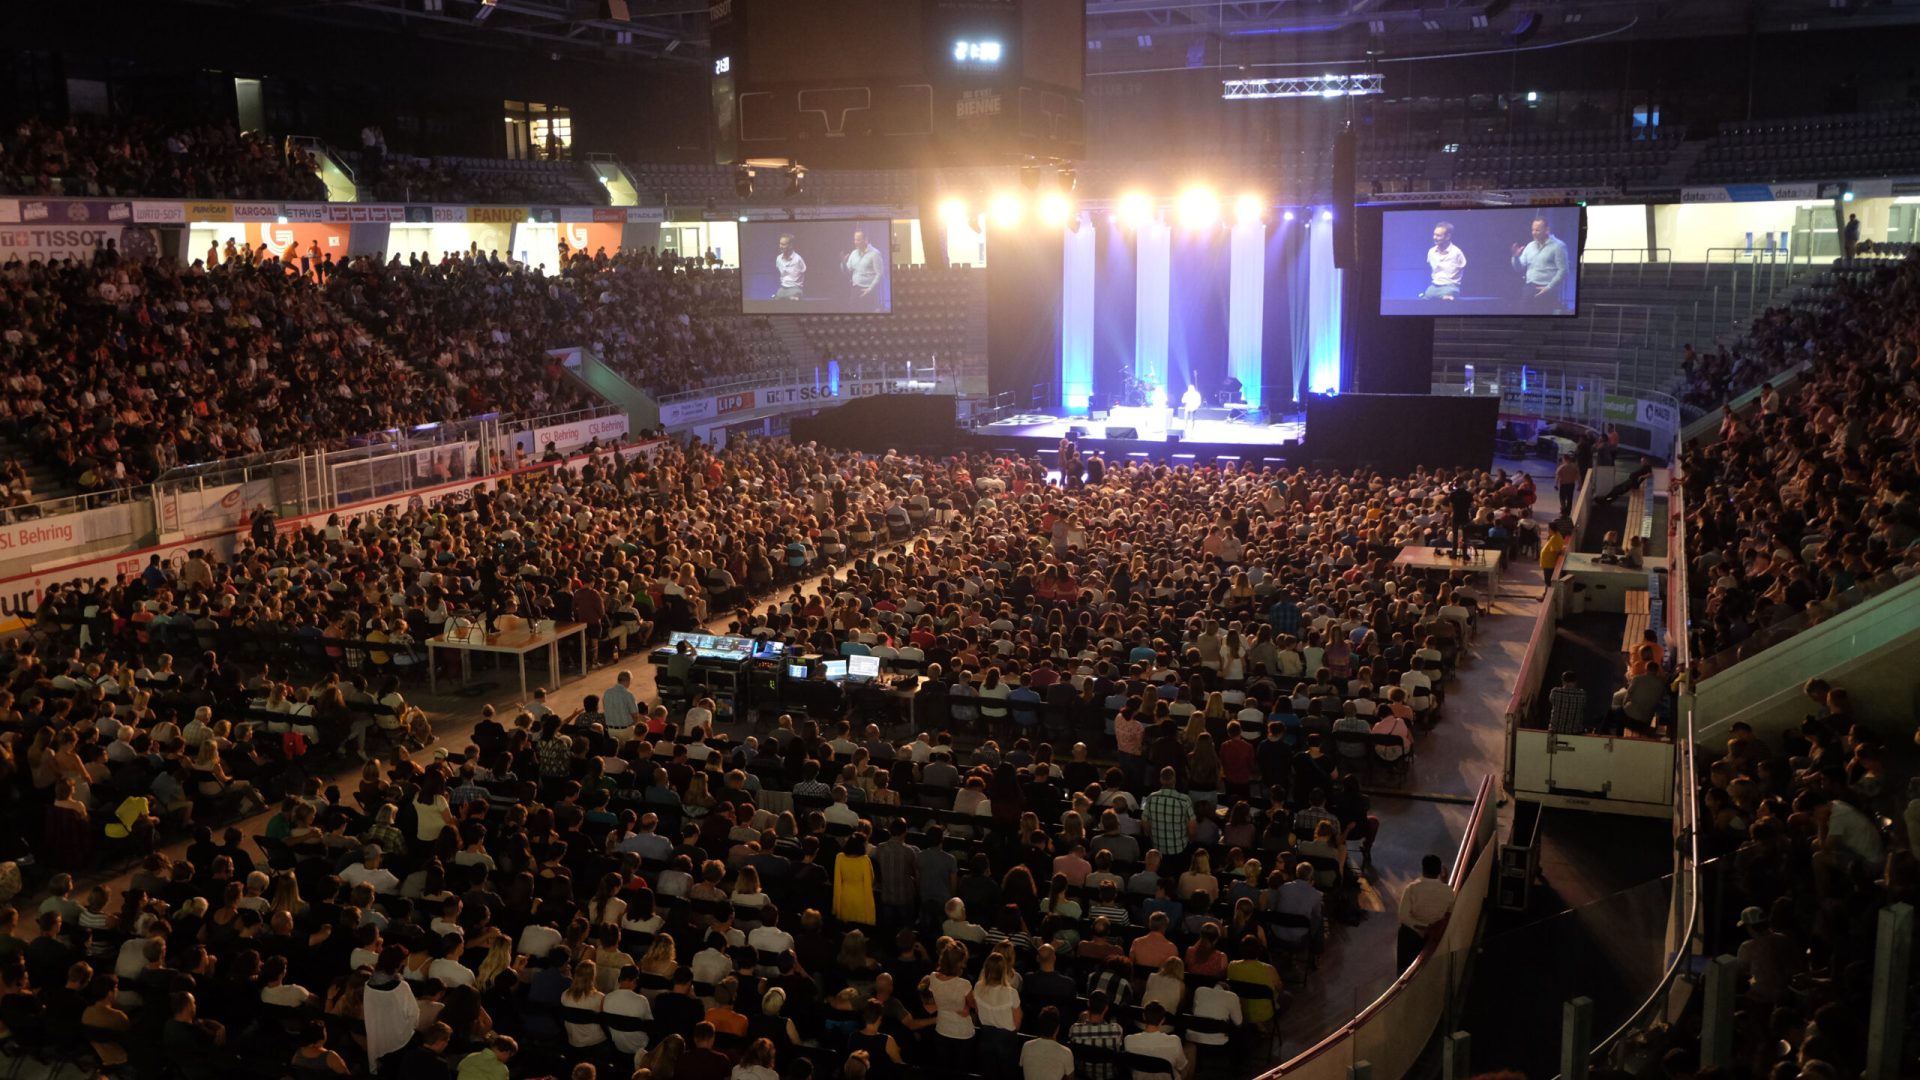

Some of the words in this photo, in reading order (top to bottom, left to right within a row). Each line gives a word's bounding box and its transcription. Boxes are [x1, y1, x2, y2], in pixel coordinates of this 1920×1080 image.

[956, 98, 1001, 116] BIENNE
[234, 206, 278, 217] KARGOAL
[473, 209, 523, 222] FANUC
[30, 230, 107, 247] TISSOT
[718, 396, 743, 411] LIPO
[589, 423, 601, 435] CSL
[601, 420, 625, 433] Behring
[540, 432, 552, 444] CSL
[554, 429, 579, 442] Behring
[355, 503, 400, 525] TISST
[0, 533, 15, 550] SL
[19, 525, 74, 546] Behring
